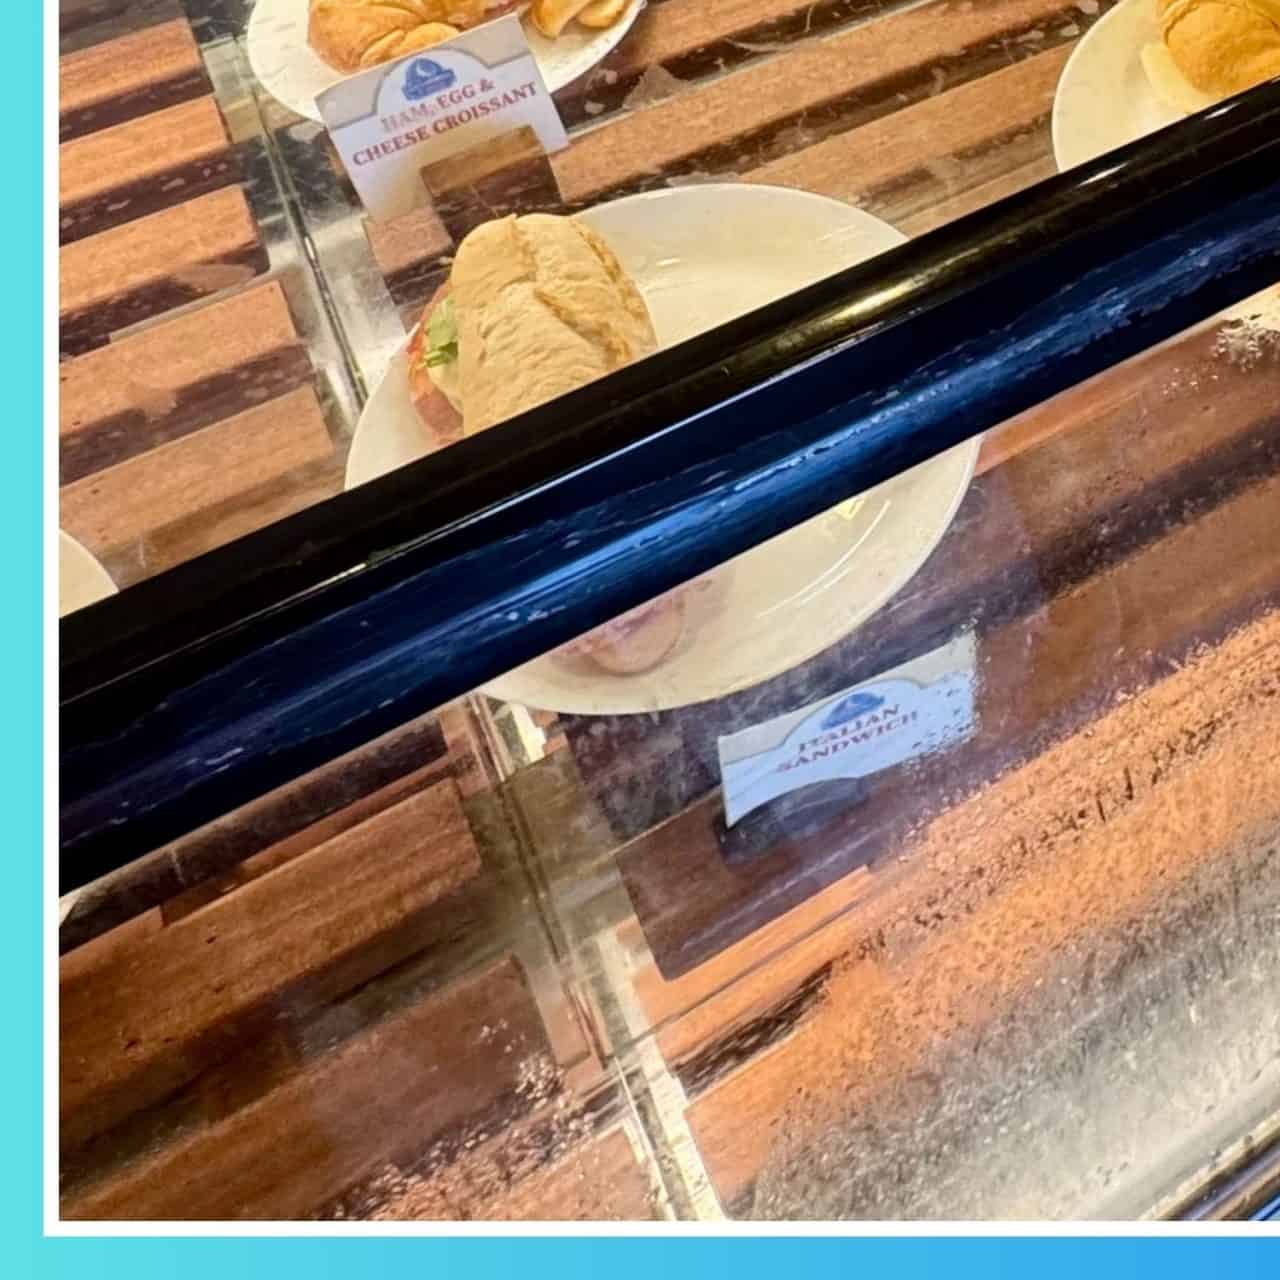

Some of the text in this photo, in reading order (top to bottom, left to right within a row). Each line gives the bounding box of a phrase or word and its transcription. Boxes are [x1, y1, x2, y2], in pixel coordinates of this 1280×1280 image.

[437, 84, 476, 111] EGG
[479, 78, 496, 94] &
[352, 126, 432, 167] CHEESE
[431, 80, 538, 135] CROISSANT
[776, 710, 919, 773] SANDWICH
[799, 703, 901, 753] ITALIAN
